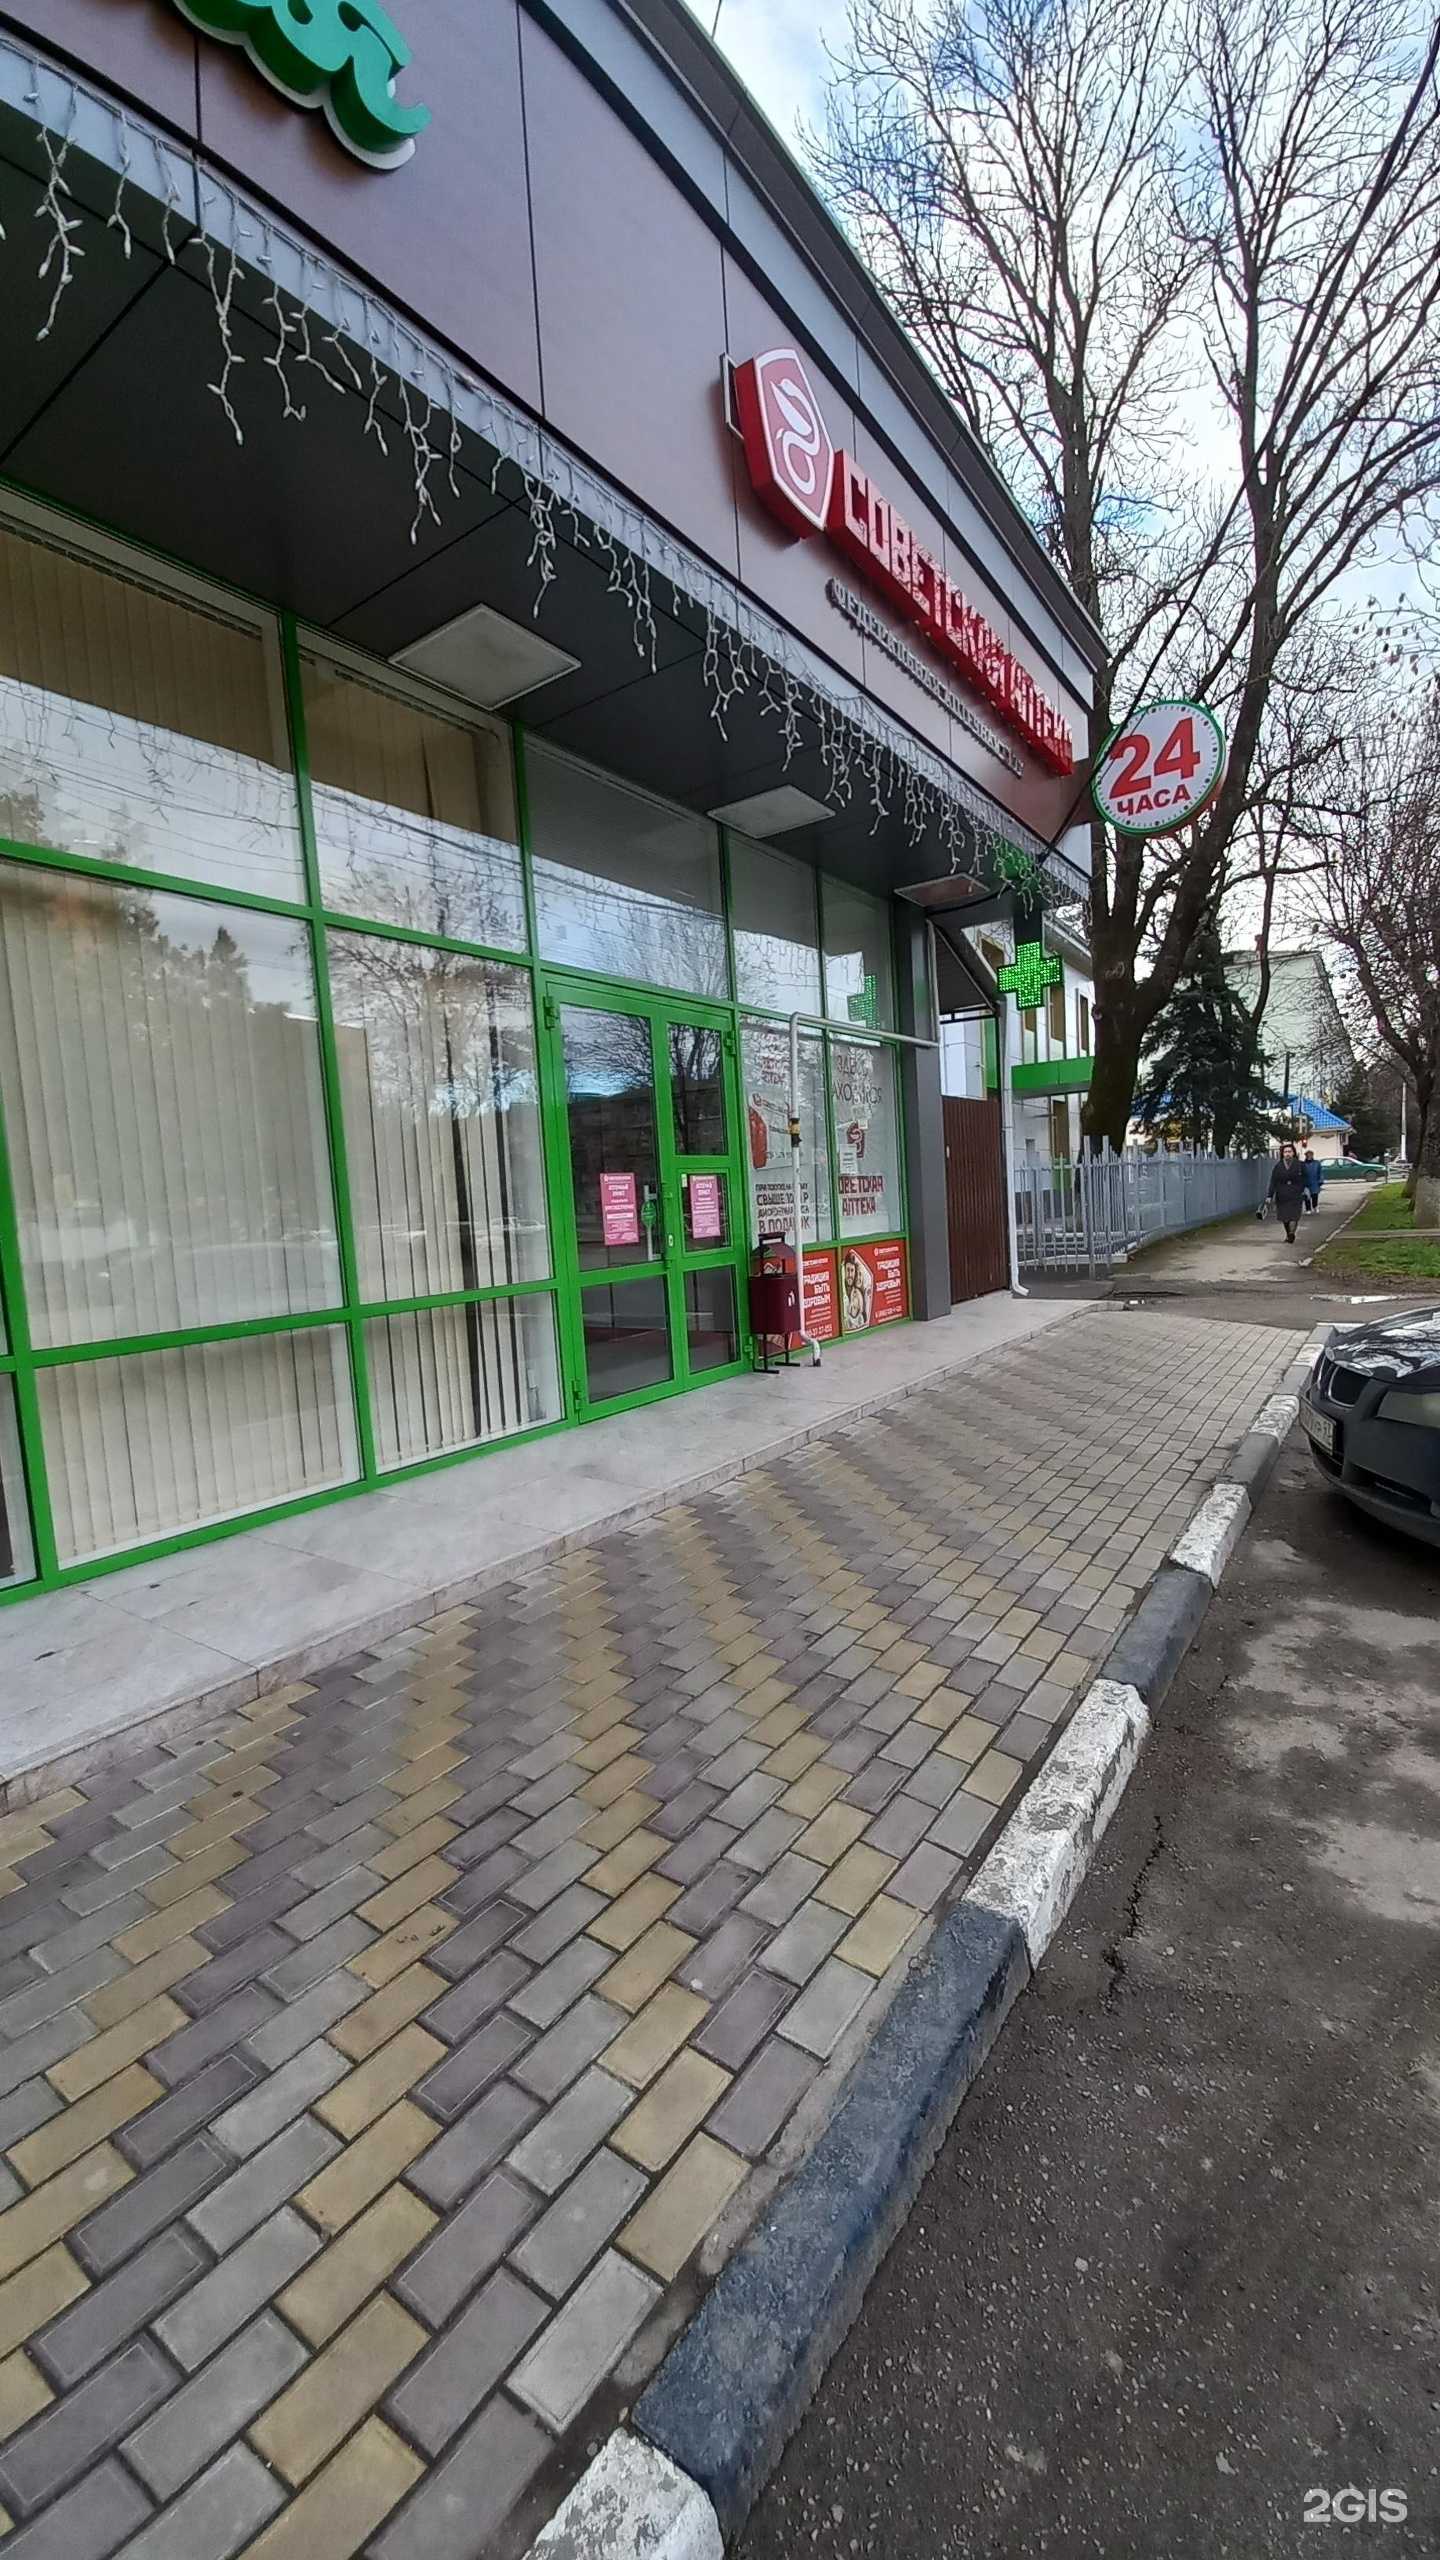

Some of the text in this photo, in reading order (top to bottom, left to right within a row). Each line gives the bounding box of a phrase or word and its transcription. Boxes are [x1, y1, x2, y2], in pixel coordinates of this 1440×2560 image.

[842, 449, 1006, 699] СОВЕТСКАЯ
[1109, 716, 1201, 799] 24
[1117, 784, 1192, 816] ЧАСА
[838, 1175, 884, 1194] ОВЕТСКАЯ
[842, 1196, 877, 1217] АПТЕКА
